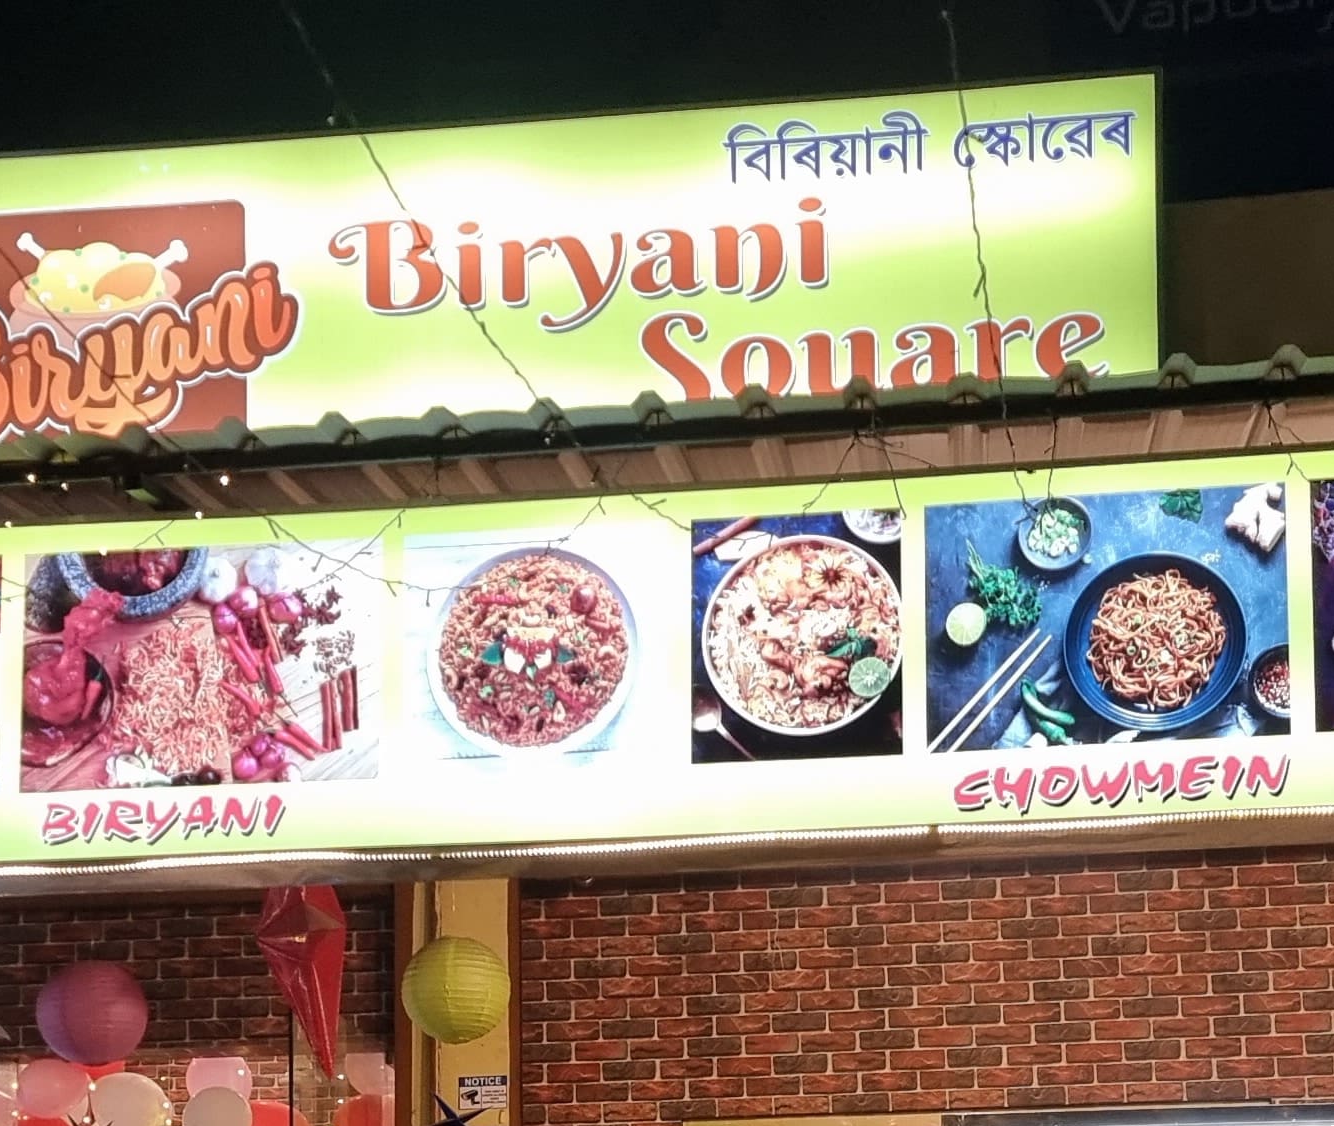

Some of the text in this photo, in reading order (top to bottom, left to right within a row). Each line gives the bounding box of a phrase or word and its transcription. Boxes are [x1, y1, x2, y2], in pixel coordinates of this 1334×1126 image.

[1098, 0, 1315, 35] Vapo
[328, 197, 830, 333] Biryani
[953, 753, 1291, 816] CHOWMEIN
[42, 795, 286, 845] BIRYANI
[464, 1076, 502, 1087] NOTICE
